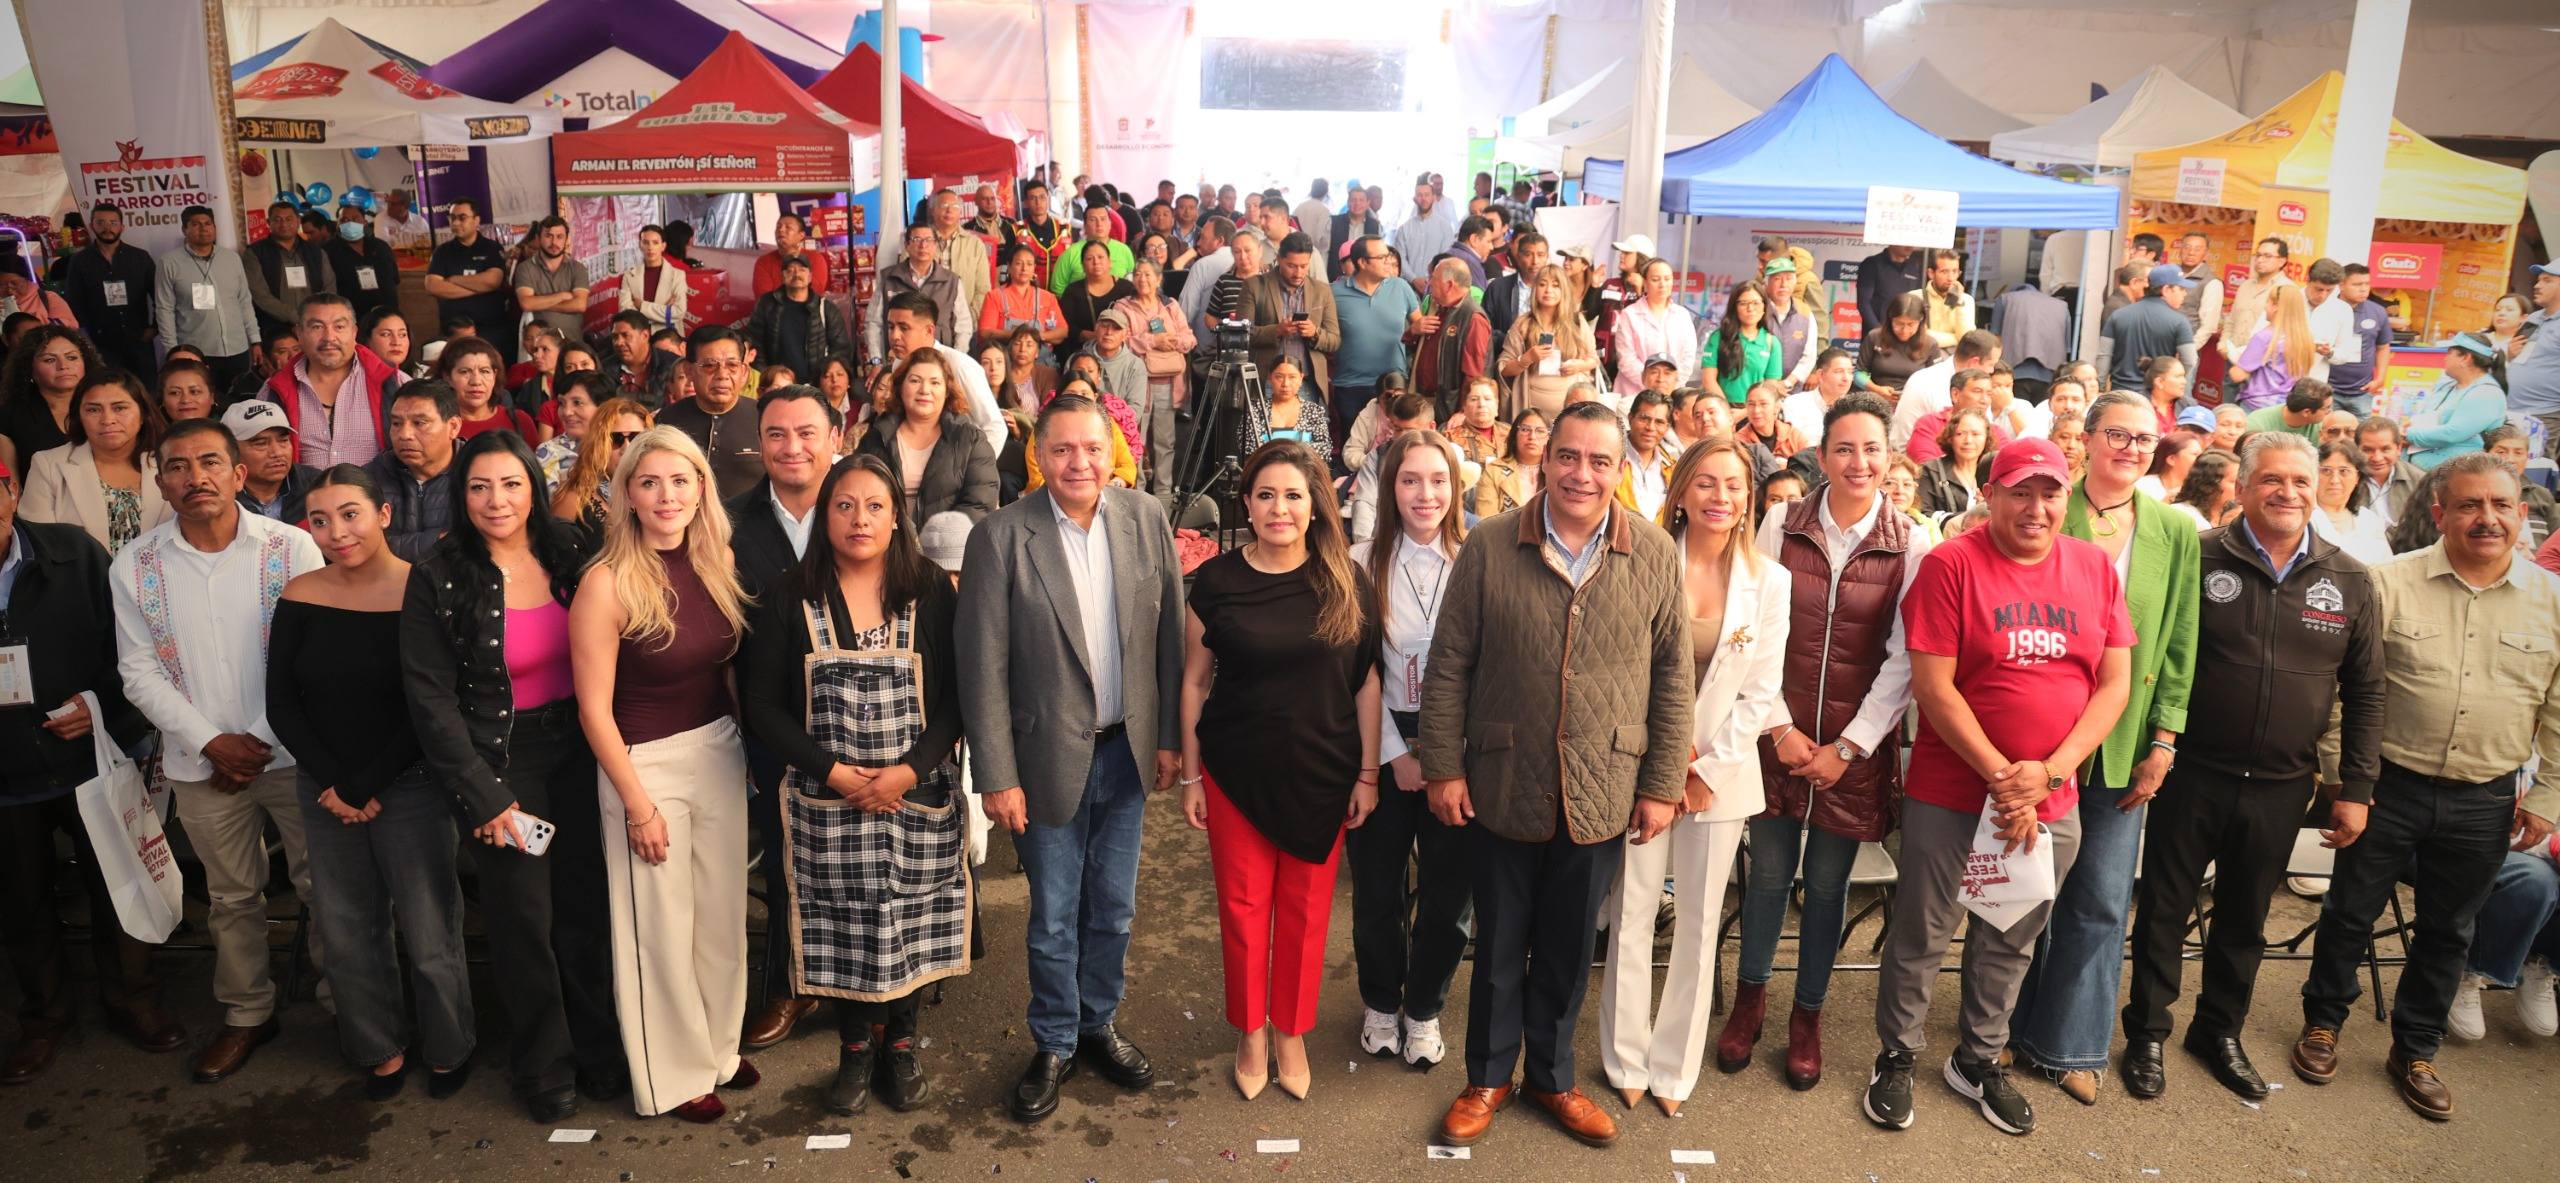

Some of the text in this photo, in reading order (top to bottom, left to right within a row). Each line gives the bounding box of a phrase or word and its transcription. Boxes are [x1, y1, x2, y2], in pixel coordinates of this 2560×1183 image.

[238, 119, 322, 141] ODERNA
[572, 154, 756, 172] ARMAN EL REVENTÓN ¡SÍ SEÑOR!
[94, 173, 200, 195] FESTIVAL
[125, 210, 179, 227] Toluca
[248, 404, 267, 414] NIKE
[1994, 603, 2078, 635] MIAMI
[2302, 610, 2348, 623] CONGRESO
[2006, 629, 2067, 660] 1996
[1409, 664, 1418, 702] EXPOSITOR
